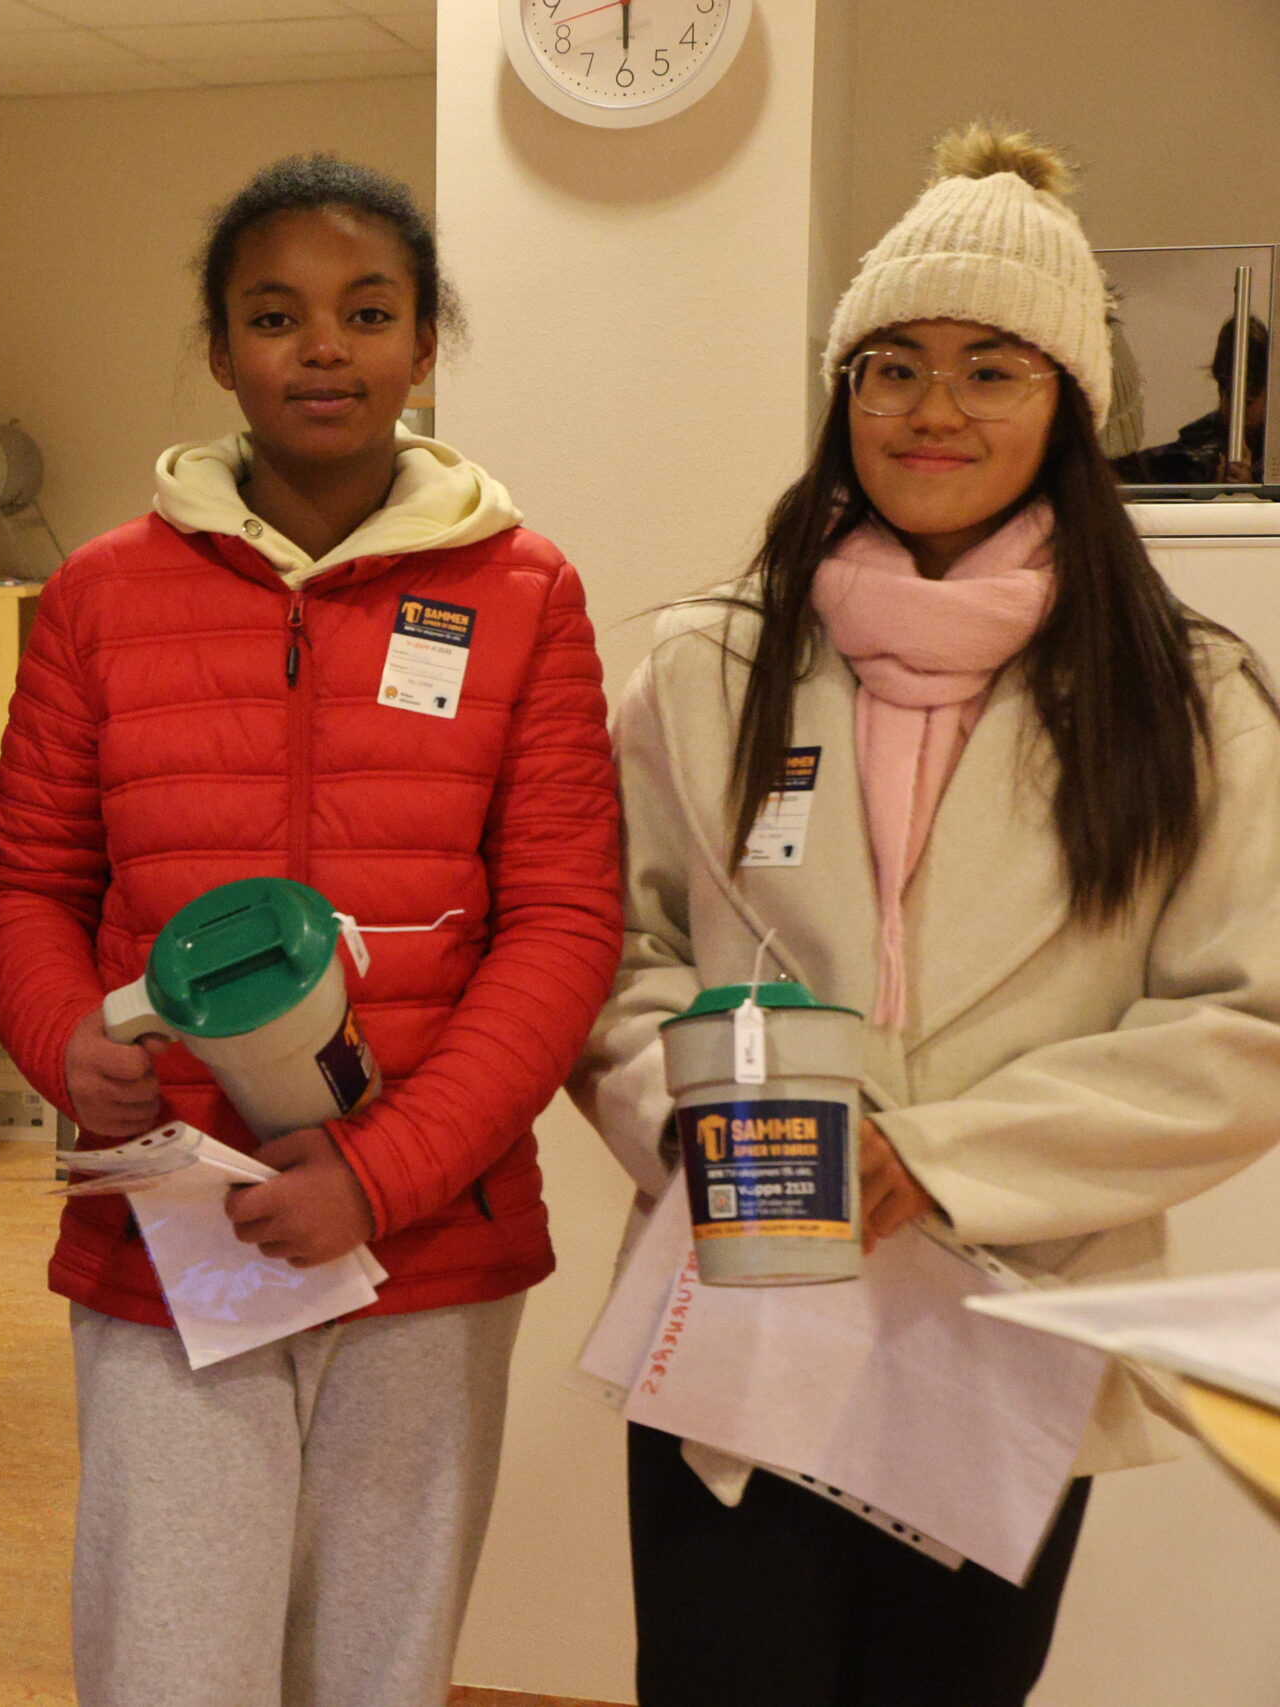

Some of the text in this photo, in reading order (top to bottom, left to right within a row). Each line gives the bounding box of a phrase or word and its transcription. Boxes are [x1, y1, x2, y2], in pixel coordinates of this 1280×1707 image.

[555, 24, 571, 54] 8
[678, 22, 697, 50] 4
[580, 52, 594, 77] 7
[615, 58, 634, 88] 6
[652, 49, 670, 77] 5
[424, 607, 470, 626] SAMMEN
[730, 1117, 817, 1142] SAMMEN
